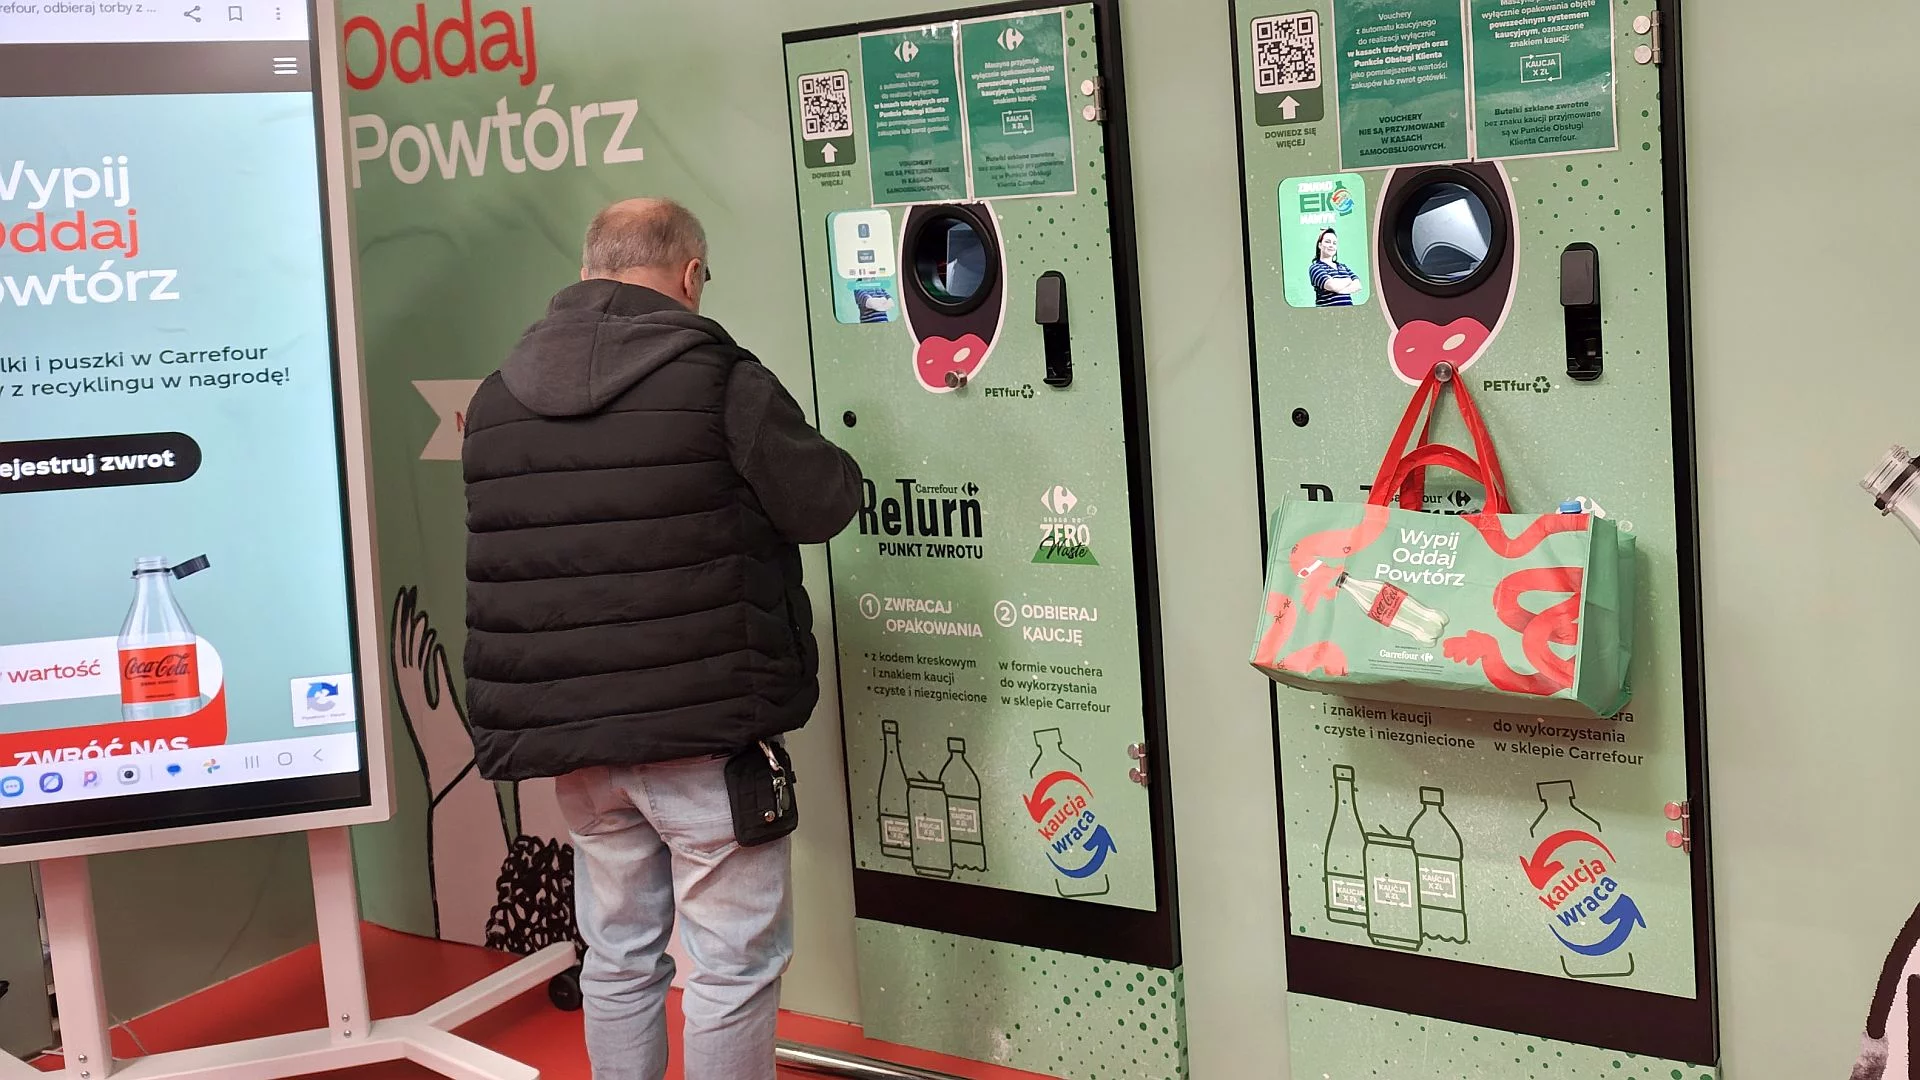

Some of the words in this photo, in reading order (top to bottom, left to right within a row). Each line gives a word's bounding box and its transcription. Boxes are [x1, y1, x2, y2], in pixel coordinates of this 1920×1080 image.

[43, 1, 96, 16] odbieraj
[99, 1, 133, 15] torby
[135, 4, 143, 13] z
[1378, 11, 1412, 20] Vouchery
[1481, 8, 1520, 19] wyłącznie
[1521, 2, 1569, 14] opakowania
[1570, 0, 1596, 8] objęte
[1362, 24, 1395, 34] automatu
[1396, 19, 1437, 29] kaucyjnego
[1489, 16, 1546, 30] powszechnym
[1547, 11, 1589, 23] systemem
[1369, 34, 1400, 44] realizacji
[1401, 30, 1436, 40] wyłącznie
[1495, 27, 1540, 39] kaucyjnym,
[1542, 23, 1585, 33] oznaczone
[343, 0, 538, 90] Oddaj
[1355, 47, 1381, 56] kasach
[1383, 41, 1431, 53] tradycyjnych
[1509, 38, 1542, 48] znakiem
[1354, 58, 1384, 67] Punkcie
[1385, 53, 1415, 63] Obsługi
[1415, 51, 1442, 60] Klienta
[1525, 59, 1556, 68] KAUCJA
[1350, 71, 1365, 80] jako
[1366, 66, 1416, 78] pomniejszenie
[1418, 61, 1448, 71] wartości
[1351, 81, 1382, 89] zakupów
[1396, 76, 1416, 84] zwrot
[1417, 72, 1448, 83] gotówki.
[1495, 107, 1522, 115] Butelki
[1556, 101, 1589, 110] zwrotne
[1379, 113, 1423, 123] VOUCHERY
[1500, 118, 1522, 126] znaku
[1524, 115, 1546, 123] kaucji
[1549, 111, 1601, 122] przyjmowane
[348, 83, 644, 189] Powtórz
[1264, 129, 1302, 139] DOWIEDZ
[1304, 127, 1317, 136] SIĘ
[1359, 128, 1371, 136] NIE
[1373, 127, 1384, 135] SĄ
[1385, 121, 1446, 134] PRZYJMOWANE
[1501, 129, 1510, 137] są
[1520, 126, 1551, 134] Punkcie
[1553, 122, 1584, 131] Obsługi
[1276, 138, 1306, 149] WIĘCEJ
[1390, 134, 1423, 144] KASACH
[1510, 137, 1536, 146] Klienta
[1538, 134, 1577, 144] Carrefour.
[1360, 143, 1446, 156] SAMOOBSŁUGOWYCH.
[0, 208, 139, 258] ddaj
[0, 260, 180, 306] wtórz
[1, 356, 27, 373] lki
[35, 355, 40, 371] i
[49, 351, 124, 375] puszki
[131, 353, 152, 366] w
[159, 346, 268, 365] Carrefour
[11, 384, 24, 397] z
[32, 376, 154, 398] recyklingu
[161, 375, 182, 389] w
[189, 367, 290, 389] nagrodę!
[1483, 380, 1531, 392] PETfur
[985, 387, 1020, 398] PETfur
[0, 453, 95, 480] ejestruj
[100, 449, 175, 471] zwrot
[915, 484, 958, 494] Carrefour
[859, 478, 983, 538] ReTurn
[1040, 523, 1090, 548] ZERO
[1400, 527, 1460, 551] Wypij
[878, 542, 922, 557] PUNKT
[926, 543, 983, 559] ZWROTU
[1040, 536, 1088, 559] Waste
[1392, 547, 1457, 569] Oddaj
[1375, 563, 1466, 586] Powtórz
[884, 597, 953, 614] ZWRACAJ
[1021, 604, 1098, 622] ODBIERAJ
[886, 617, 983, 638] OPAKOWANIA
[1022, 625, 1083, 647] KAUCJĘ
[871, 653, 876, 661] z
[879, 652, 914, 664] kodem
[916, 654, 976, 670] kreskowym
[1379, 649, 1419, 660] Carrefour
[7, 659, 101, 683] wartość
[125, 653, 190, 680] Coca-Cola
[998, 661, 1008, 670] w
[1011, 660, 1047, 673] formie
[1049, 665, 1103, 677] vouchera
[878, 669, 921, 681] znakiem
[924, 671, 955, 686] kaucji
[1000, 677, 1014, 688] do
[1017, 680, 1097, 694] wykorzystania
[873, 685, 906, 698] czyste
[908, 686, 912, 697] i
[914, 687, 988, 703] niezgniecione
[1001, 696, 1011, 705] w
[1014, 695, 1053, 710] sklepie
[1056, 698, 1111, 713] Carrefour
[1323, 702, 1327, 714] i
[1331, 705, 1386, 720] znakiem
[1391, 709, 1432, 727] kaucji
[1324, 724, 1366, 738] czyste
[1369, 726, 1374, 739] i
[1377, 728, 1475, 749] niezgniecione
[1493, 719, 1512, 733] do
[1516, 722, 1625, 743] wykorzystania
[1494, 741, 1507, 751] w
[1511, 742, 1565, 759] sklepie
[1569, 746, 1644, 765] Carrefour
[1038, 795, 1087, 841] kaucja
[1052, 810, 1096, 854] wraca
[1422, 874, 1451, 884] KAUCJA
[1538, 858, 1606, 911] kaucja
[1379, 884, 1407, 894] KAUCJA
[1556, 876, 1618, 926] wraca
